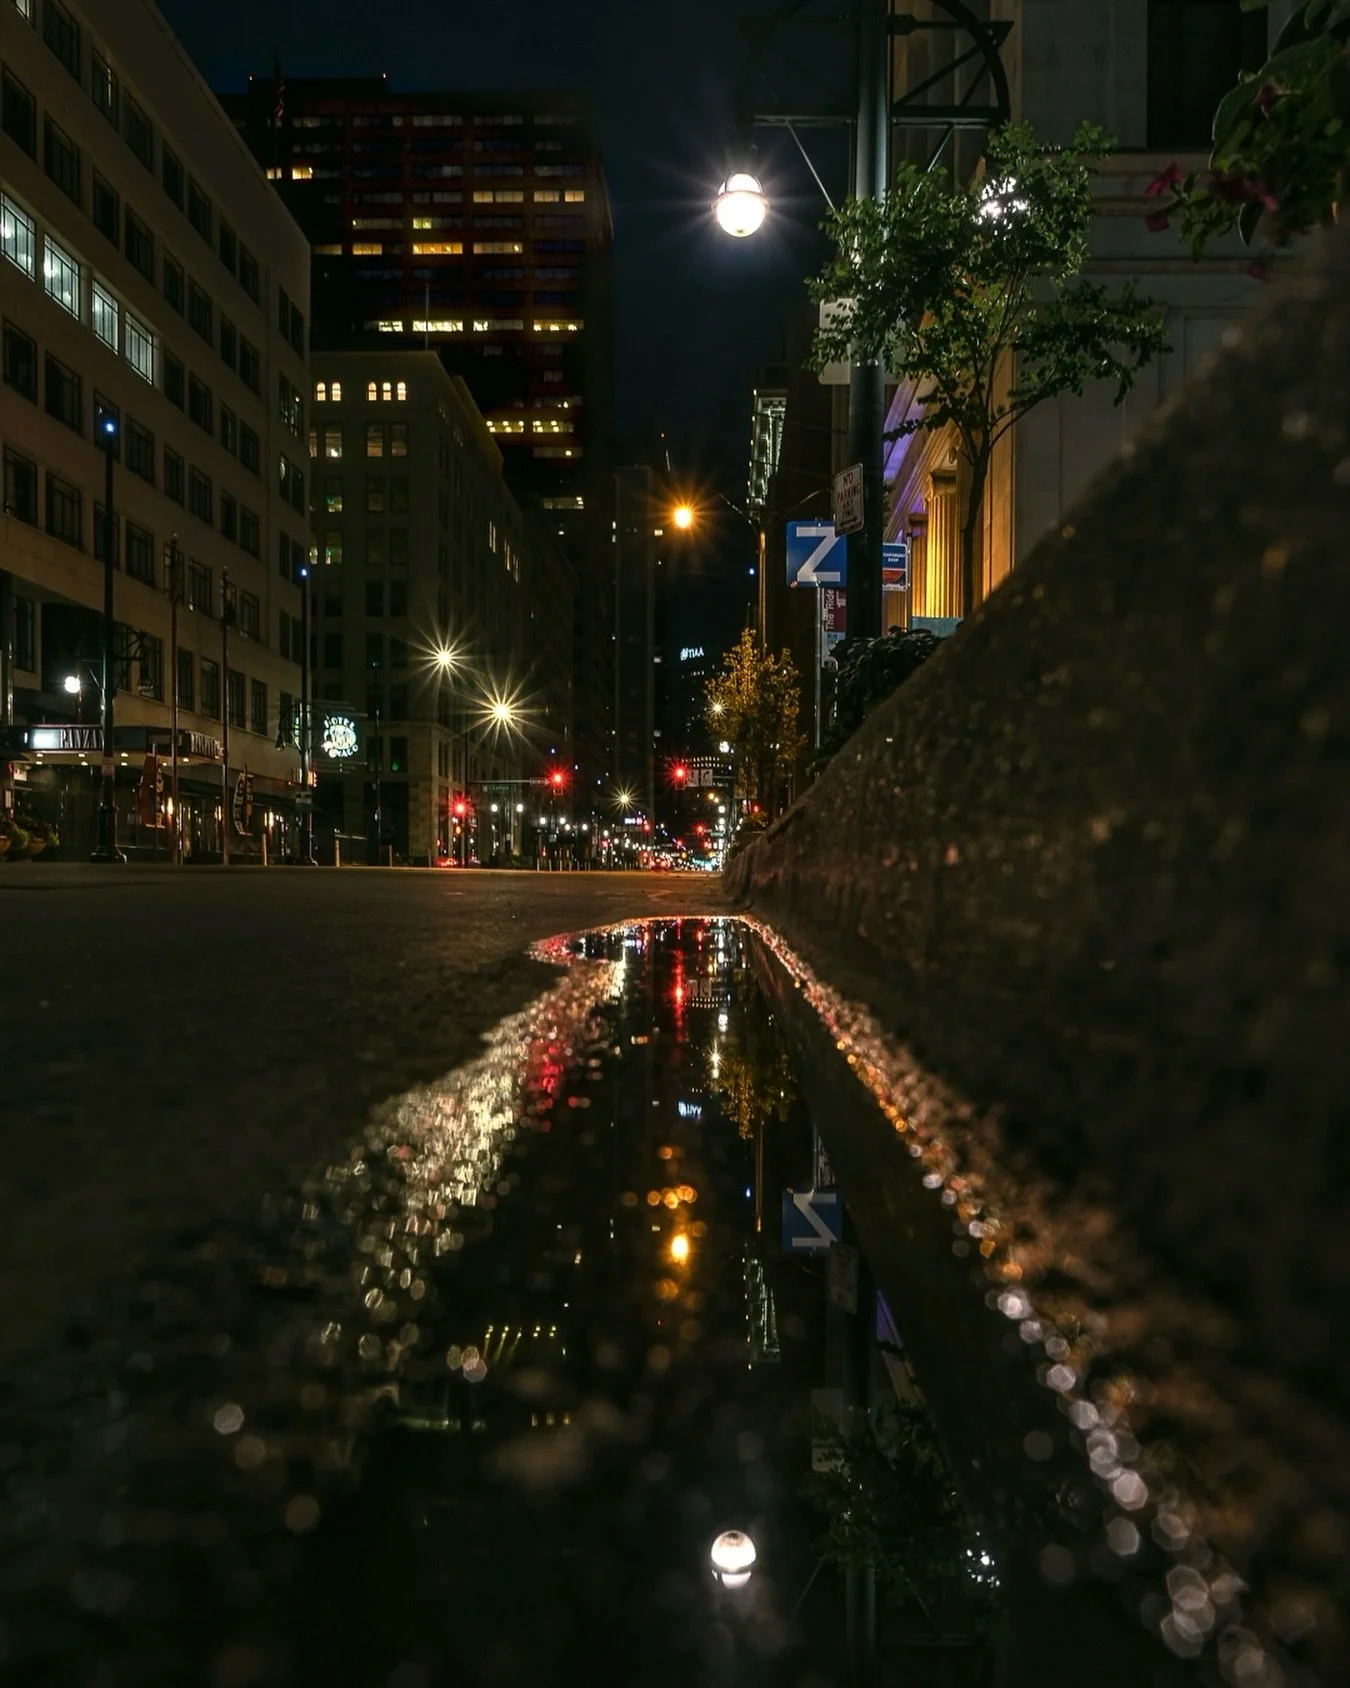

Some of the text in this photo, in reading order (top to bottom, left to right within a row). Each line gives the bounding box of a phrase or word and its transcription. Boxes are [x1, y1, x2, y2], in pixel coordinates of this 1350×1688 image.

[843, 472, 853, 487] NO
[837, 484, 861, 504] PARKING
[324, 717, 355, 731] HOTEL
